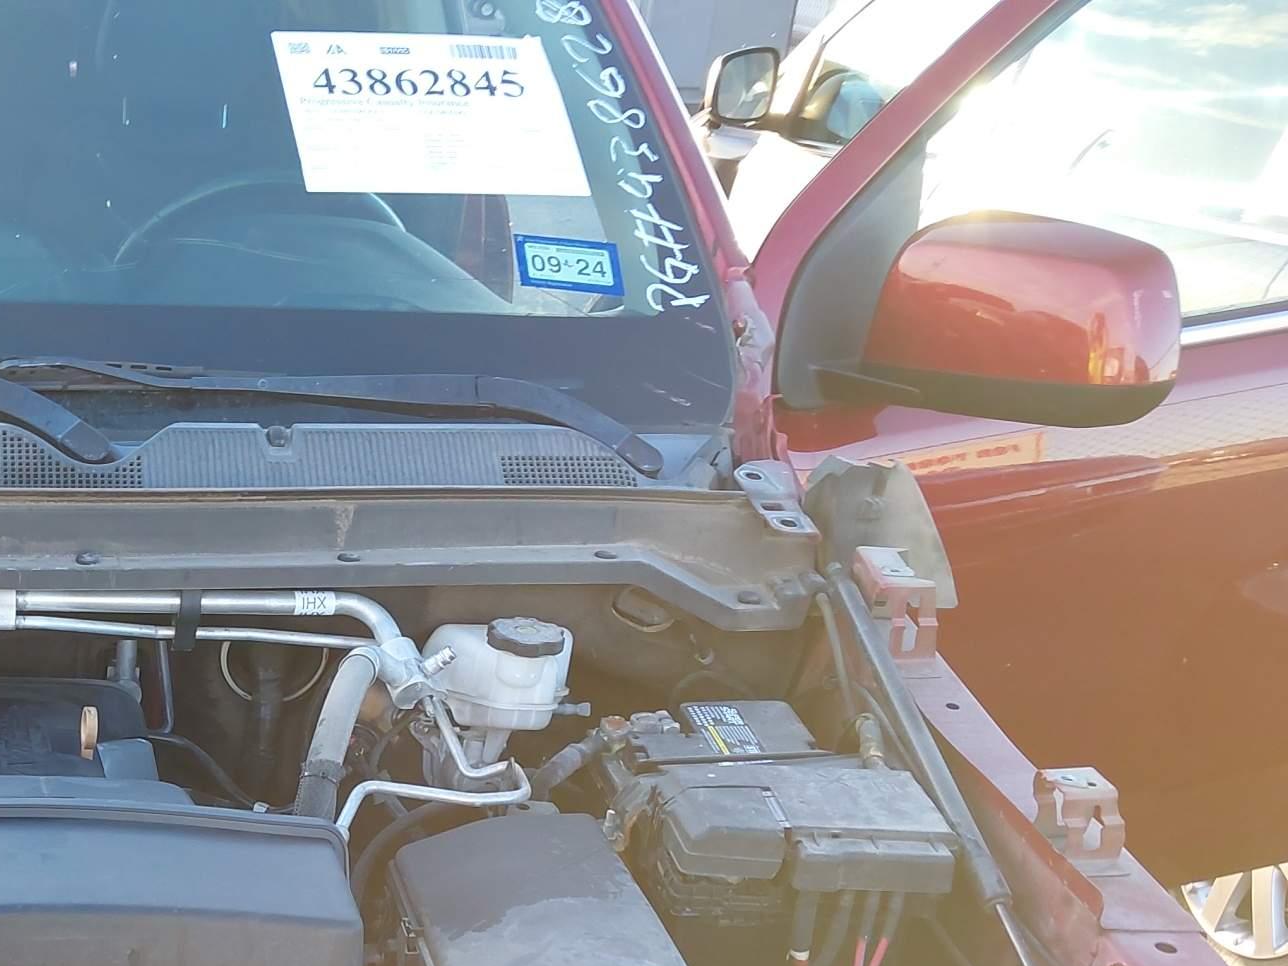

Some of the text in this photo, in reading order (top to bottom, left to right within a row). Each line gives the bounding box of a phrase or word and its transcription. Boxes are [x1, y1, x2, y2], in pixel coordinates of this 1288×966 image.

[313, 67, 524, 97] 43862845
[532, 254, 607, 278] 09 24
[302, 596, 327, 609] IHX
